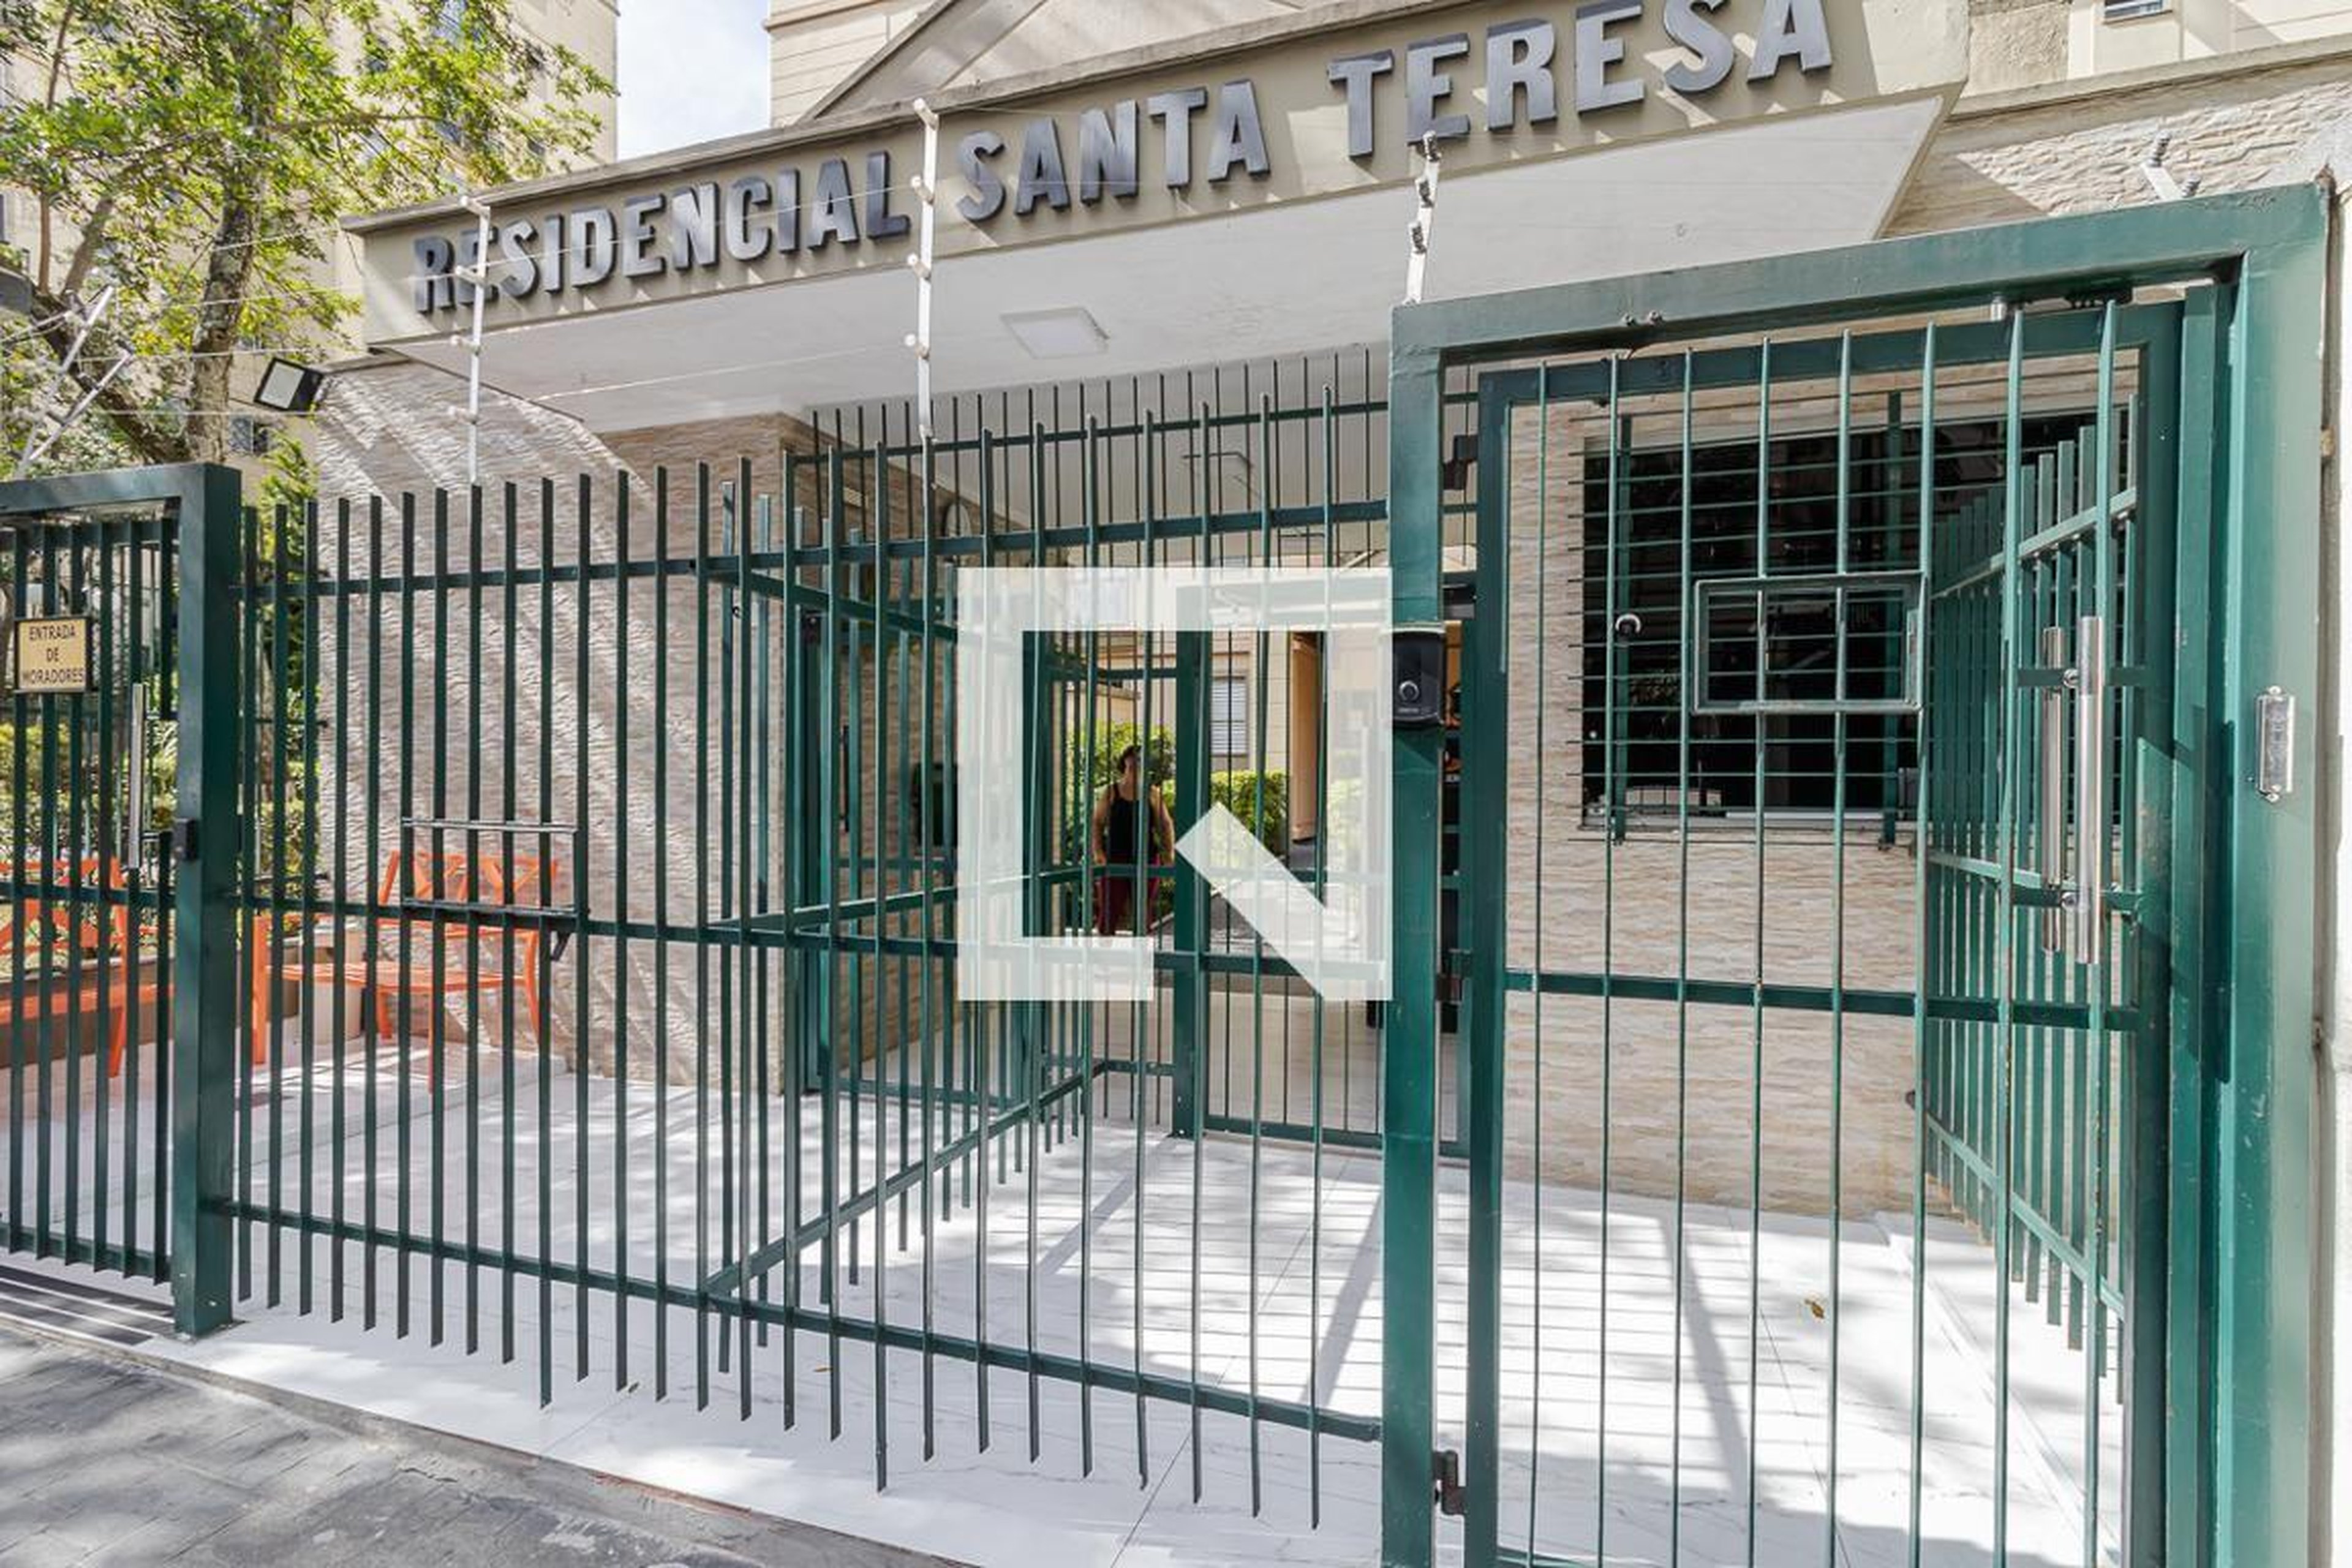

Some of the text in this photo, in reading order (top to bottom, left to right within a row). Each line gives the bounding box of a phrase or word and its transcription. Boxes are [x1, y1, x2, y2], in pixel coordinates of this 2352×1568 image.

[414, 0, 1833, 314] RESIDENCIAL SANTA TERESA
[29, 624, 75, 641] ENTRADA
[47, 647, 59, 662] DE
